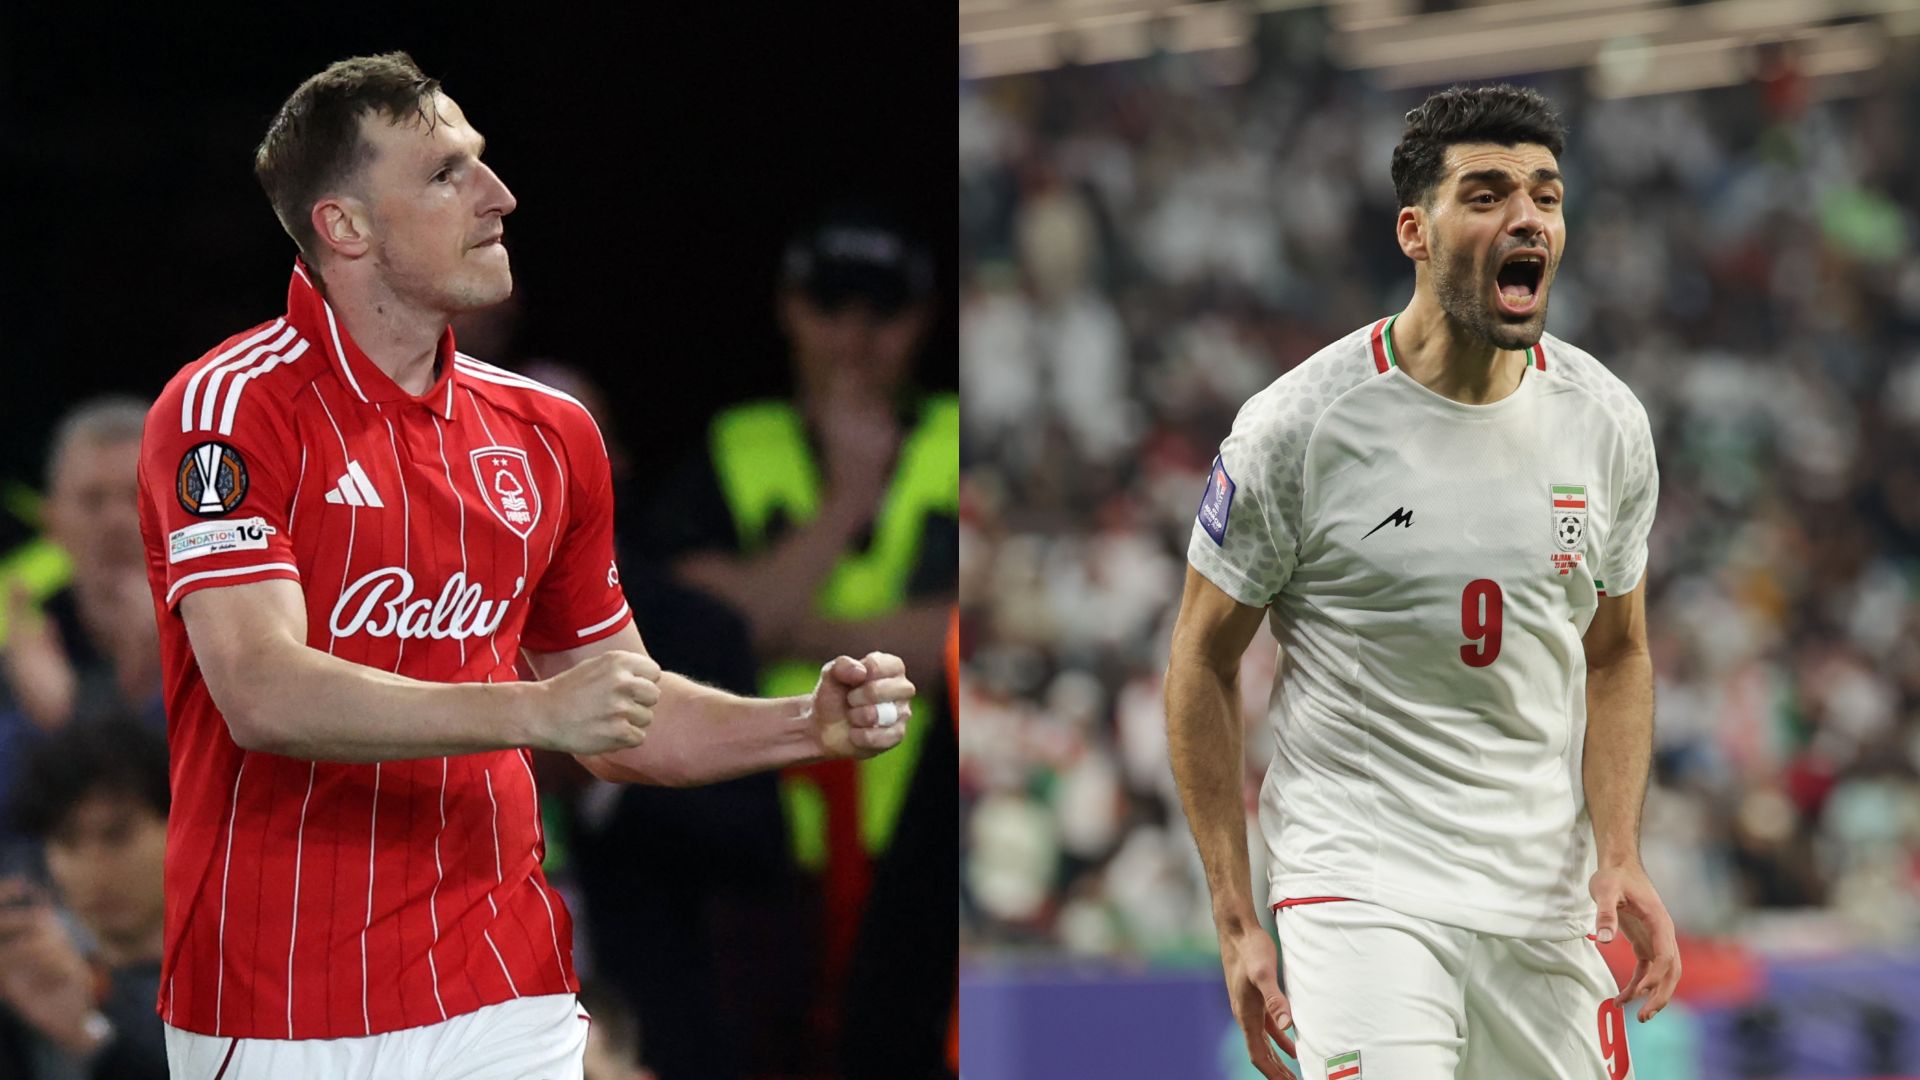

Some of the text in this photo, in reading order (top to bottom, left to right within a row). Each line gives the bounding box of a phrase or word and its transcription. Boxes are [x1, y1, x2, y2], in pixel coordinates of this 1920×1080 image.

[171, 532, 236, 551] FOUNDATION
[1460, 578, 1503, 667] 9
[1597, 997, 1630, 1080] 9
